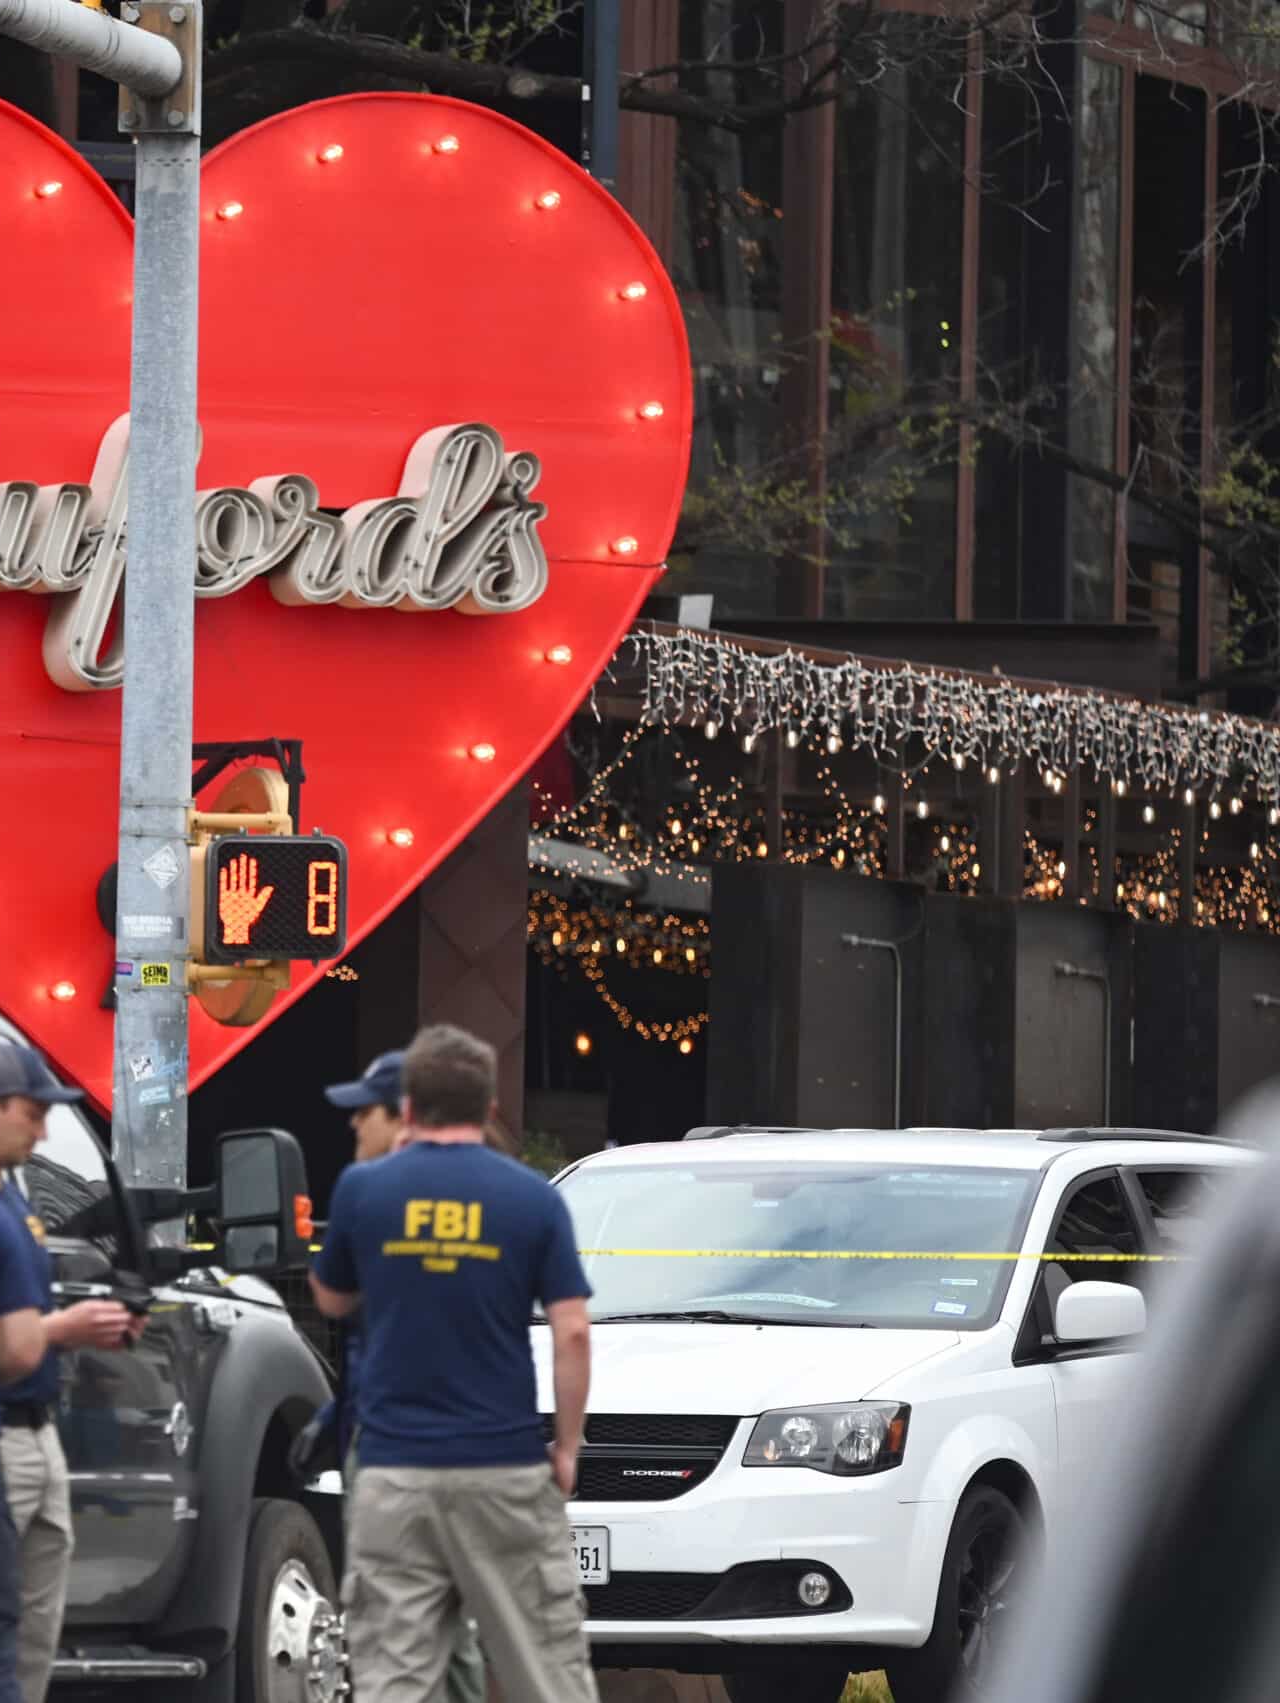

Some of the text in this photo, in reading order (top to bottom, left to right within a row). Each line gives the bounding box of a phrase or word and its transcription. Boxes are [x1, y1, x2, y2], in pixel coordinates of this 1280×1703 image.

[308, 861, 337, 935] 8
[404, 1199, 482, 1241] FBI
[623, 1469, 683, 1477] DODGE
